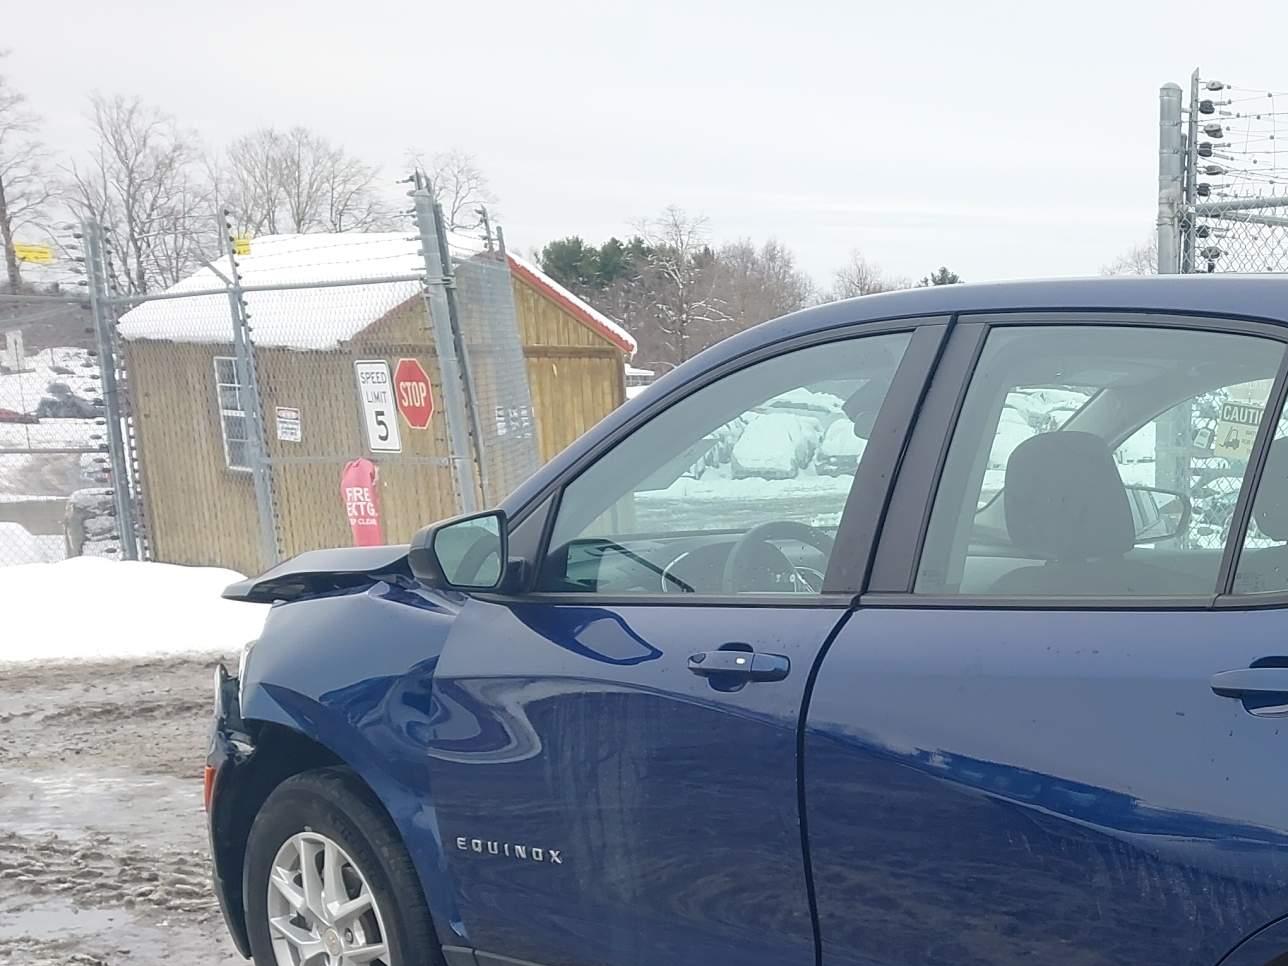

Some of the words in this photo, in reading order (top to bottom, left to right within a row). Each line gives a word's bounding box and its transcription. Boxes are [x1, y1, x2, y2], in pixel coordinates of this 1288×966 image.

[360, 372, 386, 384] SPEED
[366, 391, 386, 403] LIMIT
[400, 382, 426, 407] STOP
[375, 411, 389, 441] 5
[456, 837, 562, 864] EQUINOX
